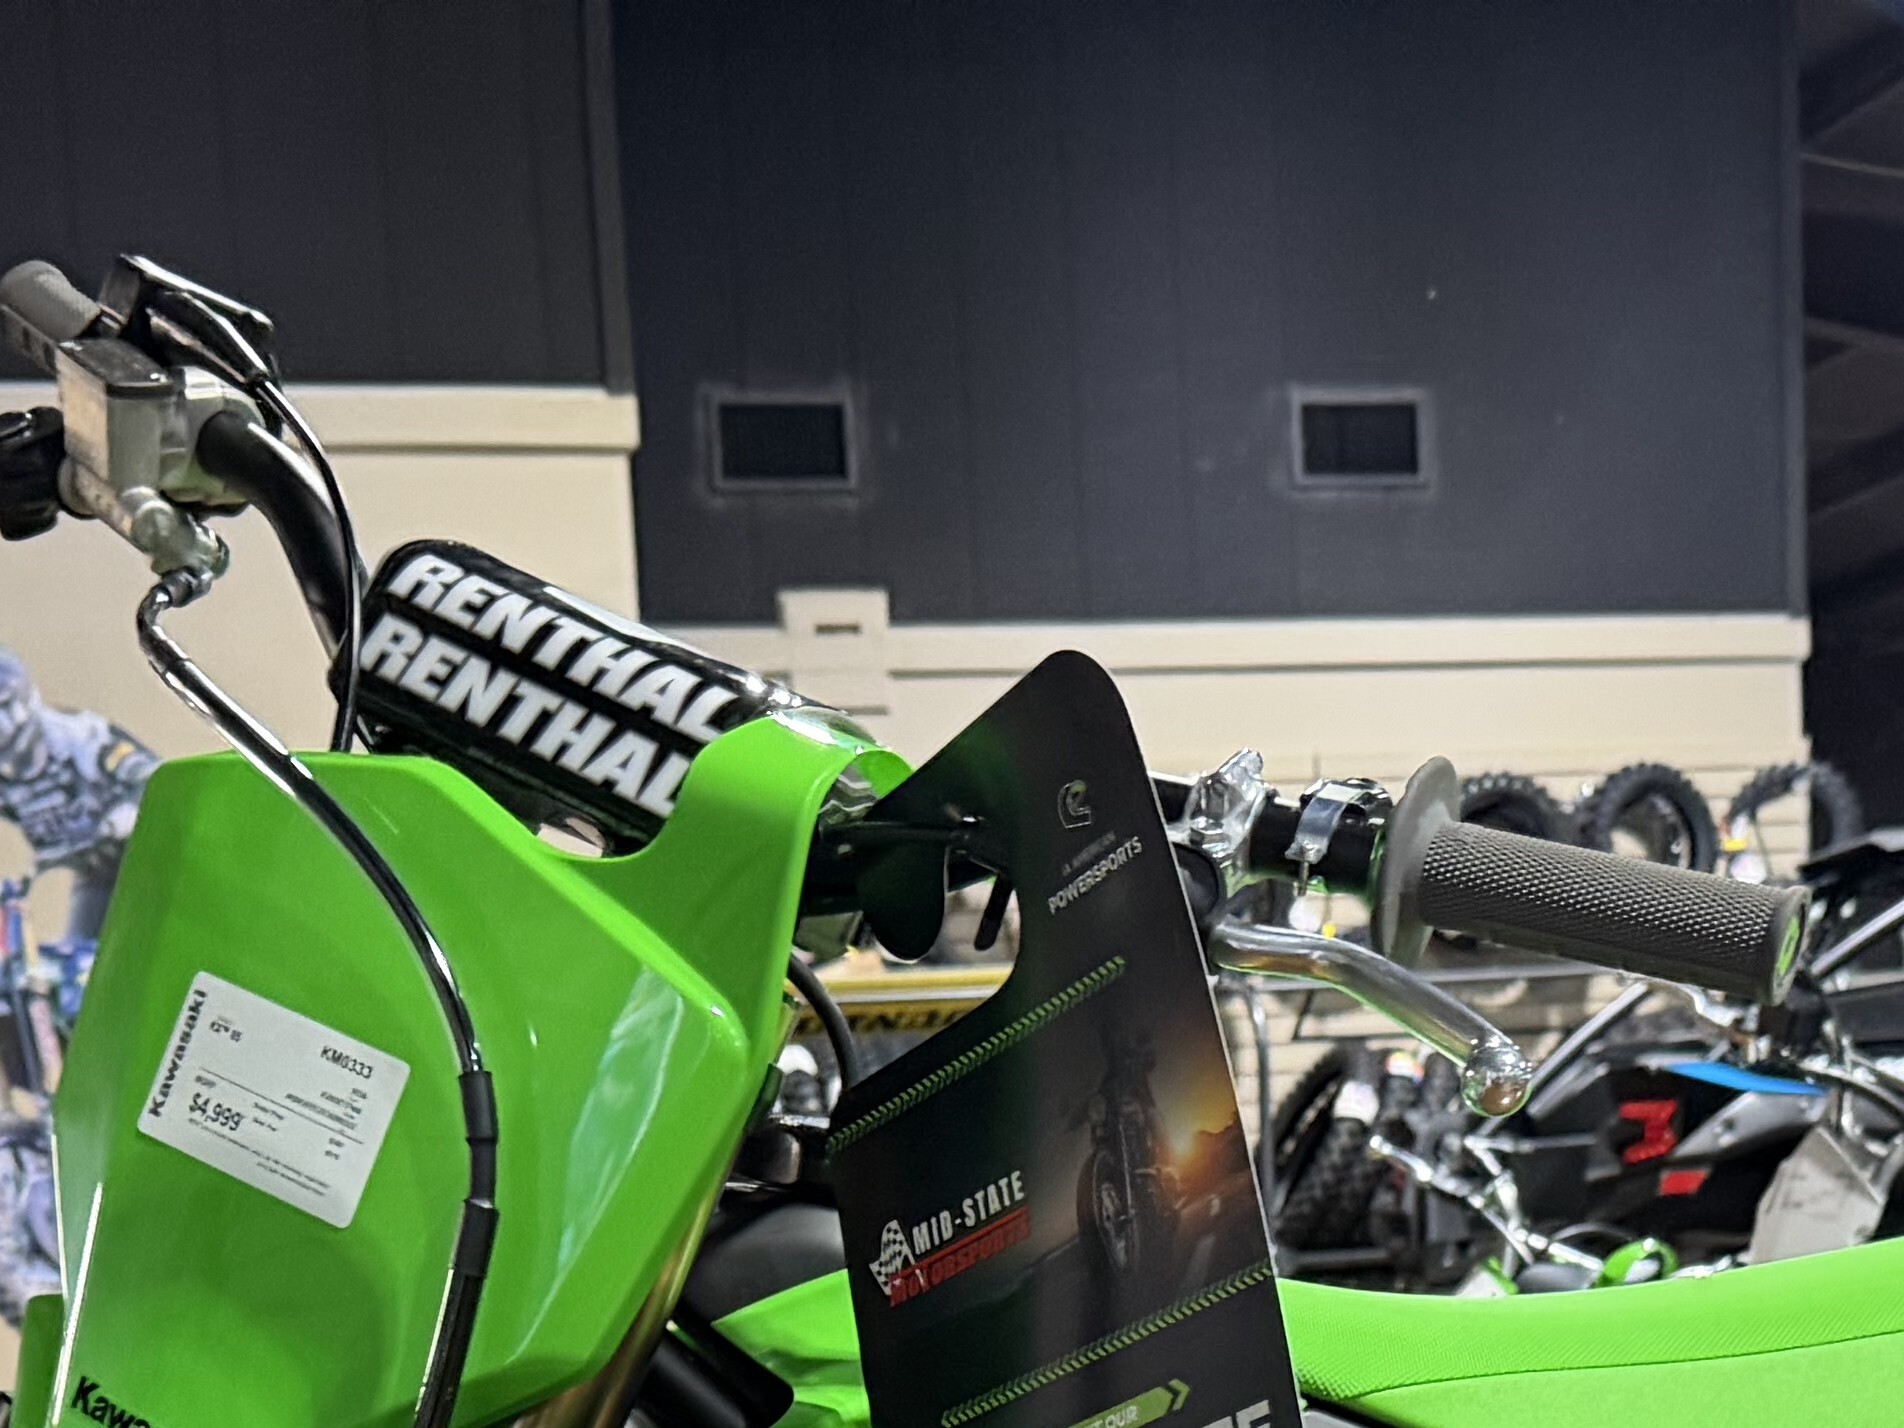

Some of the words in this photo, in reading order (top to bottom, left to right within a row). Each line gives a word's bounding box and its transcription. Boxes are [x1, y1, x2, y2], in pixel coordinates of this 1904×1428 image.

[386, 552, 741, 746] RENTHAL
[358, 611, 693, 820] RENTHAL
[1047, 835, 1143, 916] POWERSPORTS
[147, 987, 208, 1118] Kawasaki
[319, 1044, 374, 1080] KM0333
[188, 1091, 247, 1132] $4,999
[911, 1169, 1025, 1256] MID-STATE
